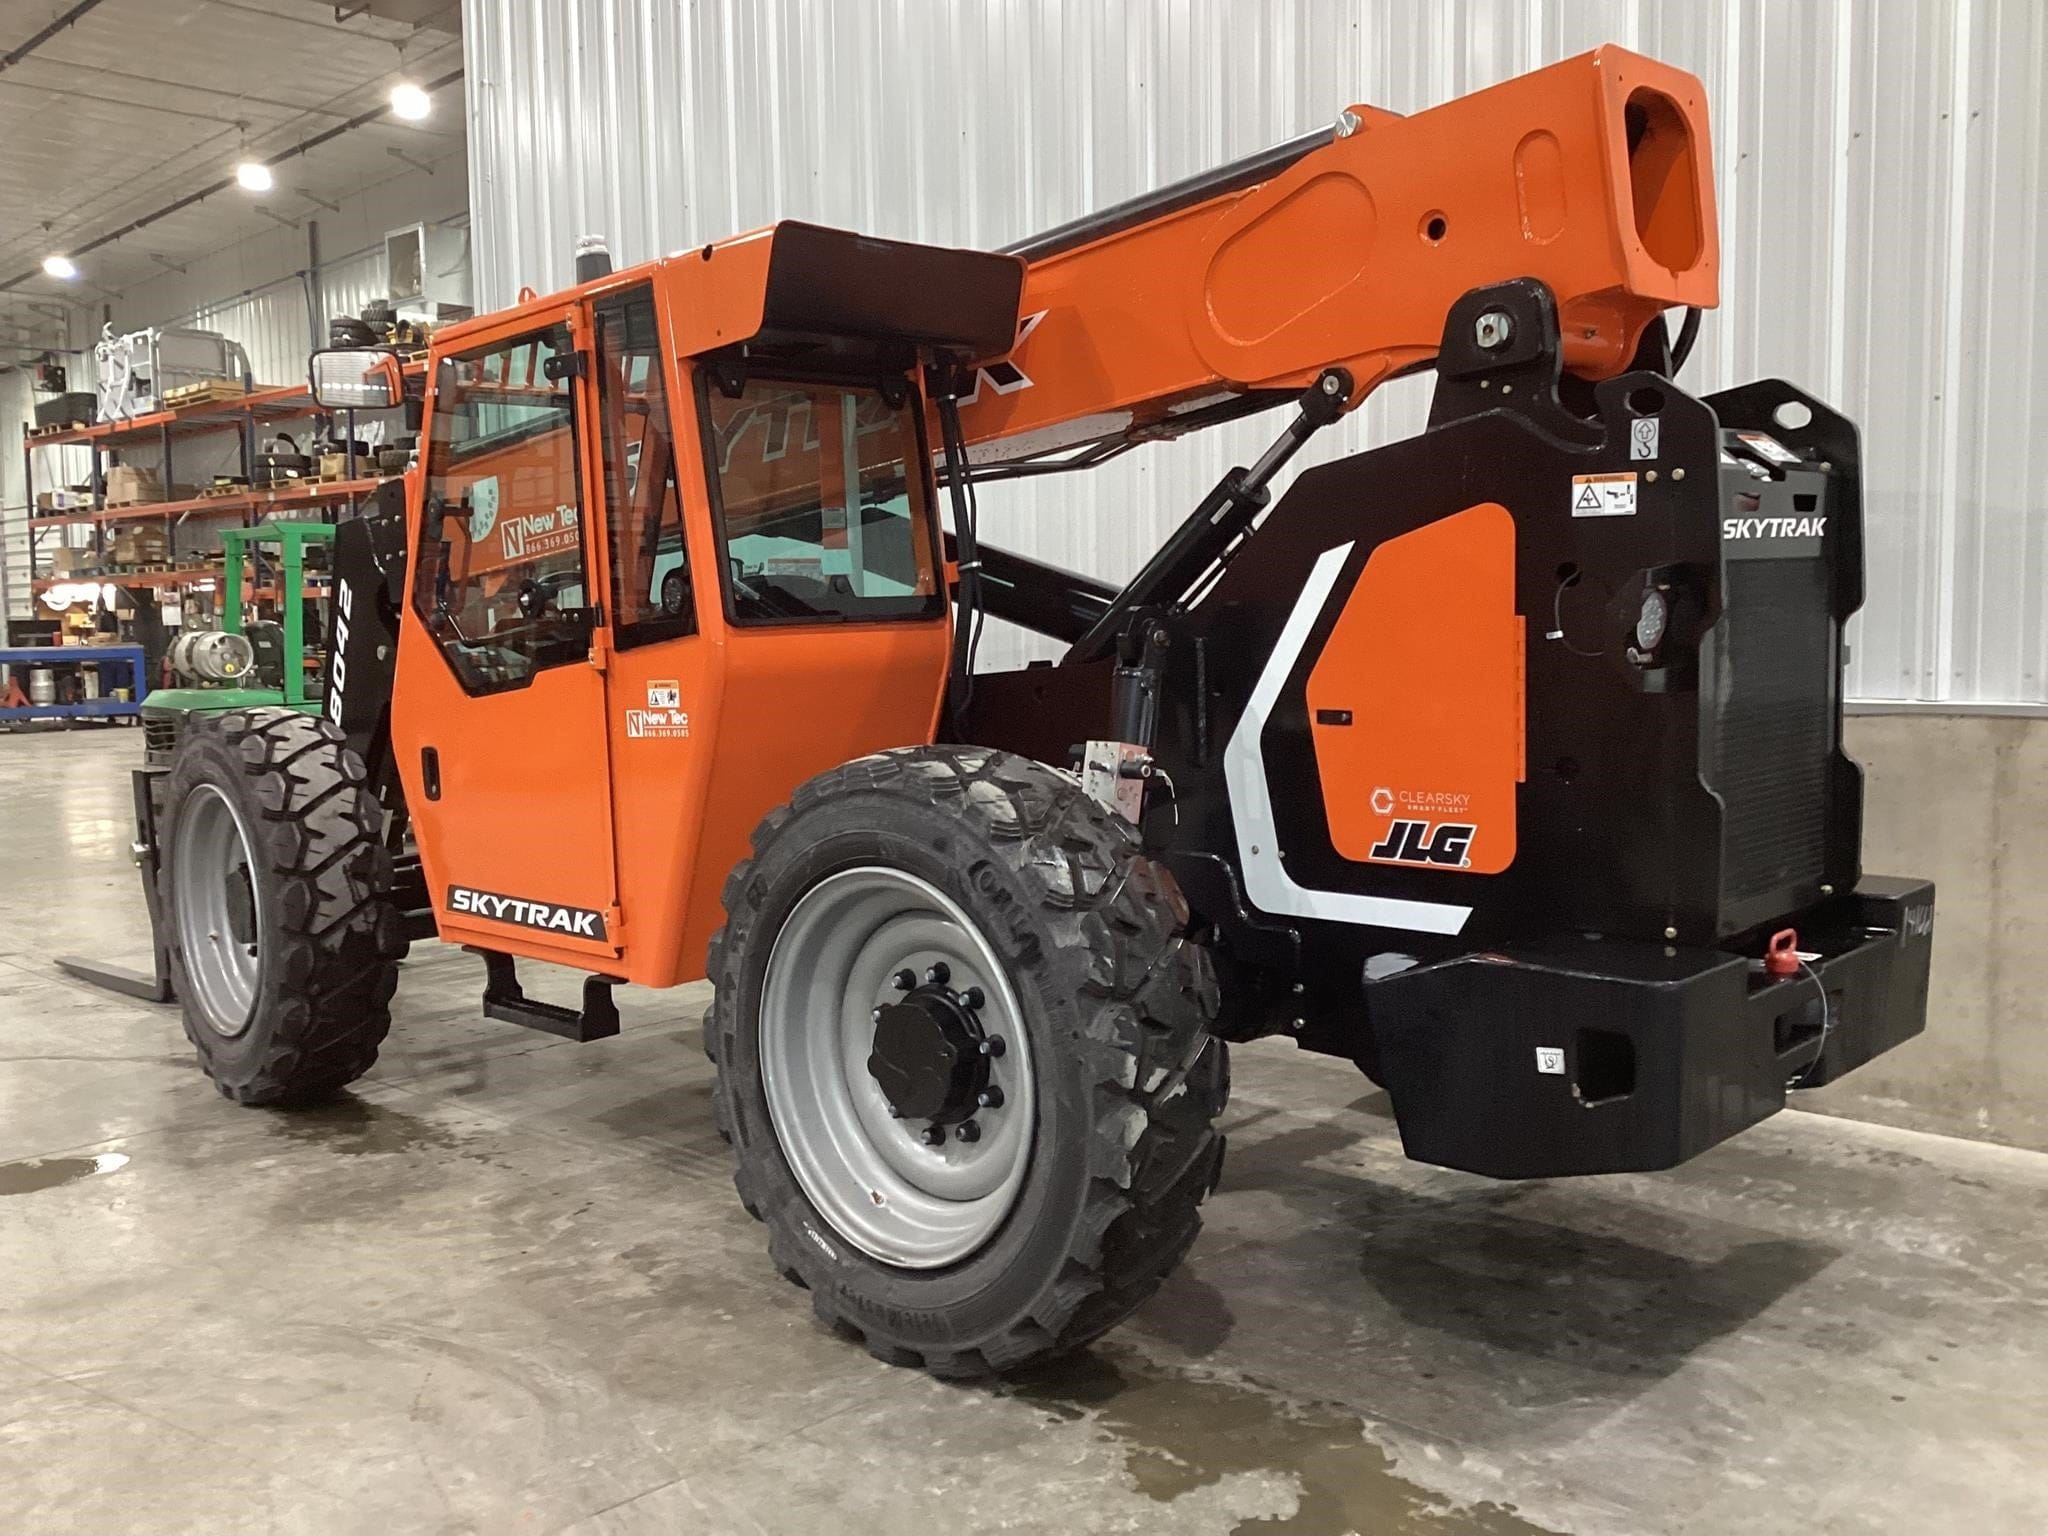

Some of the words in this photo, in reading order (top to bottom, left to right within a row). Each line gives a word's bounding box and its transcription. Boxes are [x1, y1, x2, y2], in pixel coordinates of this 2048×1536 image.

[522, 514, 555, 537] New
[1723, 517, 1827, 539] SKYTRAK
[330, 578, 352, 728] 8042
[643, 710, 667, 725] New
[668, 709, 689, 725] Tec
[1399, 790, 1471, 806] CLEARSKY
[452, 889, 597, 936] SKYTRAK
